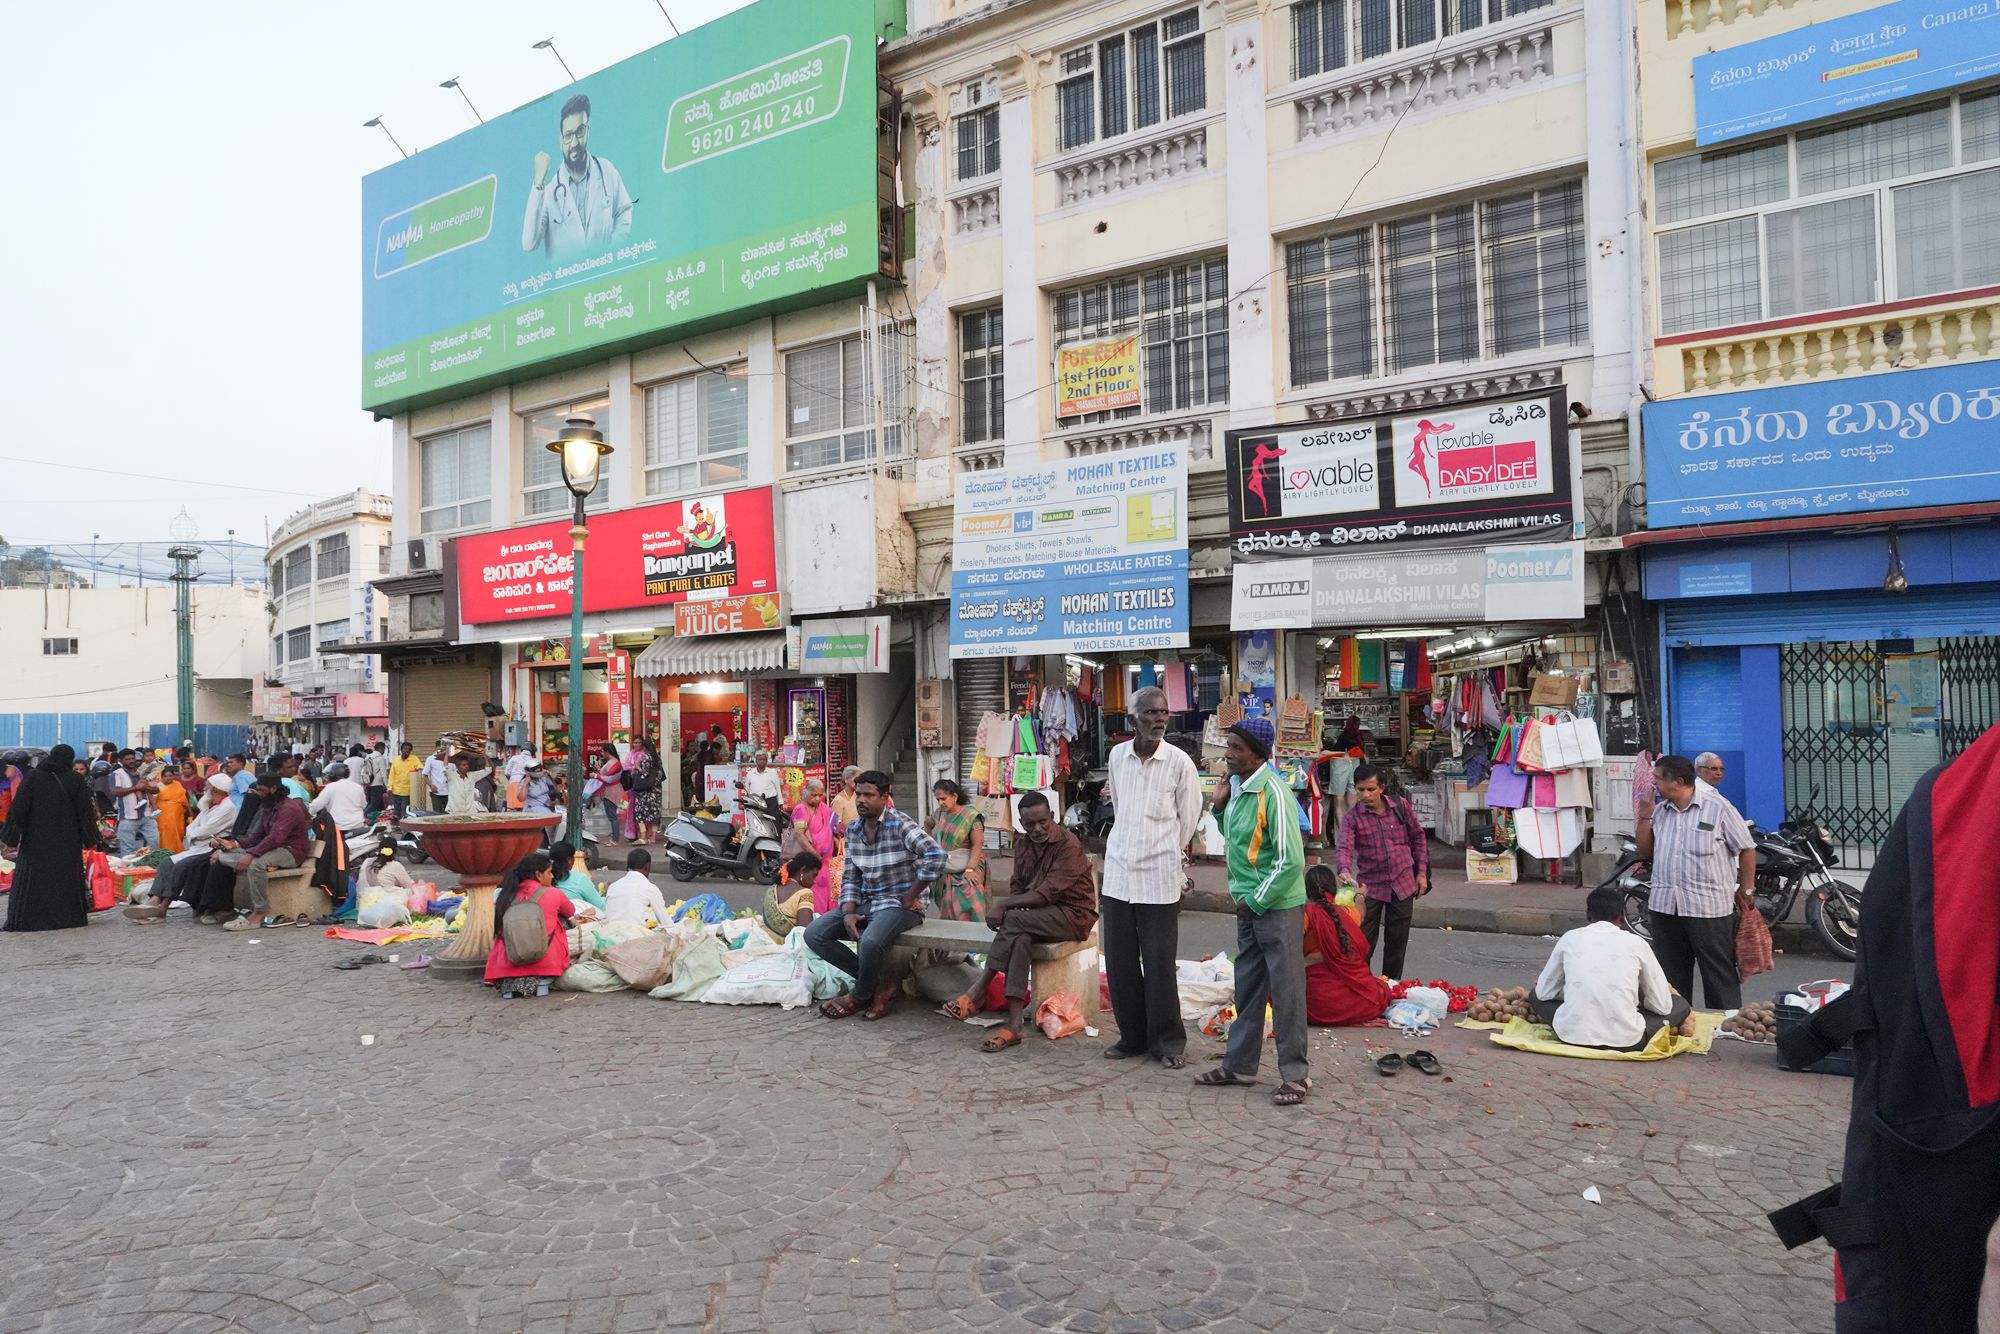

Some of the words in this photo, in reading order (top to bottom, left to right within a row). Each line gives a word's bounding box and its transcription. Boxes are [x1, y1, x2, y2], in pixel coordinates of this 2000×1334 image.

[1922, 2, 1988, 29] Canara
[685, 100, 713, 124] ನಮ್ಮ
[720, 59, 823, 111] ಹೋಮಿಯೋಪತಿ
[692, 125, 734, 154] 9620
[741, 111, 774, 138] 240
[781, 97, 815, 124] 240
[387, 224, 423, 253] NAMMA
[430, 206, 485, 234] Homeopathy
[741, 238, 785, 262] ಮಾನಸಿಕ
[790, 220, 847, 249] ಸಮಸ್ಯೆಗಳು
[741, 262, 780, 289] ಲೈಂಗಿಕ
[786, 245, 848, 273] ಸಮಸ್ಯೆಗಳು
[1062, 348, 1089, 368] FOR
[1063, 372, 1083, 384] 1st
[1088, 365, 1123, 380] Floor
[1128, 365, 1134, 373] &
[1067, 384, 1090, 399] 2nd
[1096, 380, 1132, 394] Floor
[1489, 404, 1546, 426] ಡೈಸಿಡಿ
[1679, 406, 1808, 451] ಕೆನರಾ
[1826, 387, 2000, 439] ಬ್ಯಾಂಕ
[1301, 426, 1373, 447] ಲವೇಬಲ್
[1436, 430, 1494, 450] Lovable
[1068, 463, 1113, 482] MOHAN
[1118, 452, 1176, 474] TEXTILES
[1680, 459, 1718, 475] ಭಾರತ
[1726, 453, 1784, 469] ಸರ್ಕಾರದ
[1791, 448, 1831, 463] ಒಂದು
[1840, 442, 1894, 462] ಉದ್ಯಮ
[1282, 458, 1373, 491] Lovable
[1440, 465, 1493, 486] DAISY
[1498, 461, 1535, 480] DEE
[965, 478, 1007, 494] ಮೋಹನ್
[1076, 482, 1126, 496] Matching
[1130, 475, 1166, 488] Centre
[1305, 488, 1338, 498] LIGHTLY
[1343, 484, 1374, 494] LOVELY
[1463, 484, 1500, 494] LIGHTLY
[1504, 480, 1538, 490] LOVELY
[1681, 505, 1711, 516] ಮುಖ್ಯ
[1857, 486, 1910, 502] ಮೈಸೂರು
[962, 520, 1001, 531] Poomer
[1042, 513, 1073, 523] RAMRAJ
[1331, 520, 1407, 545] ವಿಲಾಸ್
[1413, 517, 1518, 535] DHANALAKSHMI
[1521, 514, 1561, 527] VILAS
[642, 532, 654, 541] Shri
[655, 531, 670, 539] Guru
[642, 539, 681, 551] Raghavendra
[644, 543, 735, 575] Bangarpet
[1025, 551, 1057, 562] Matching
[1058, 549, 1082, 559] Blouse
[1064, 559, 1132, 576] WHOLESALE
[1135, 555, 1172, 568] RATES
[968, 573, 998, 583] ಸಗಟು
[1004, 568, 1045, 581] ಬೆಲೆಗಳು
[1487, 558, 1552, 578] Poomer
[493, 583, 532, 598] ಪಾನಿಪುರಿ
[536, 582, 544, 593] &
[646, 581, 667, 595] PANI
[670, 578, 691, 592] PURI
[694, 577, 701, 589] &
[704, 573, 735, 588] CHATS
[1252, 582, 1309, 596] RAMRAJ
[1316, 585, 1431, 606] DHANALAKSHMI
[1436, 583, 1480, 601] VILAS
[680, 604, 707, 617] FRESH
[959, 600, 998, 620] ಮೋಹನ್
[1061, 592, 1109, 615] MOHAN
[1113, 587, 1175, 611] TEXTILES
[680, 612, 743, 636] JUICE
[1064, 618, 1122, 635] Matching
[1128, 615, 1172, 631] Centre
[1073, 638, 1135, 649] WHOLESALE
[1138, 636, 1171, 646] RATES
[1243, 698, 1258, 707] VIP
[707, 774, 726, 791] Arun
